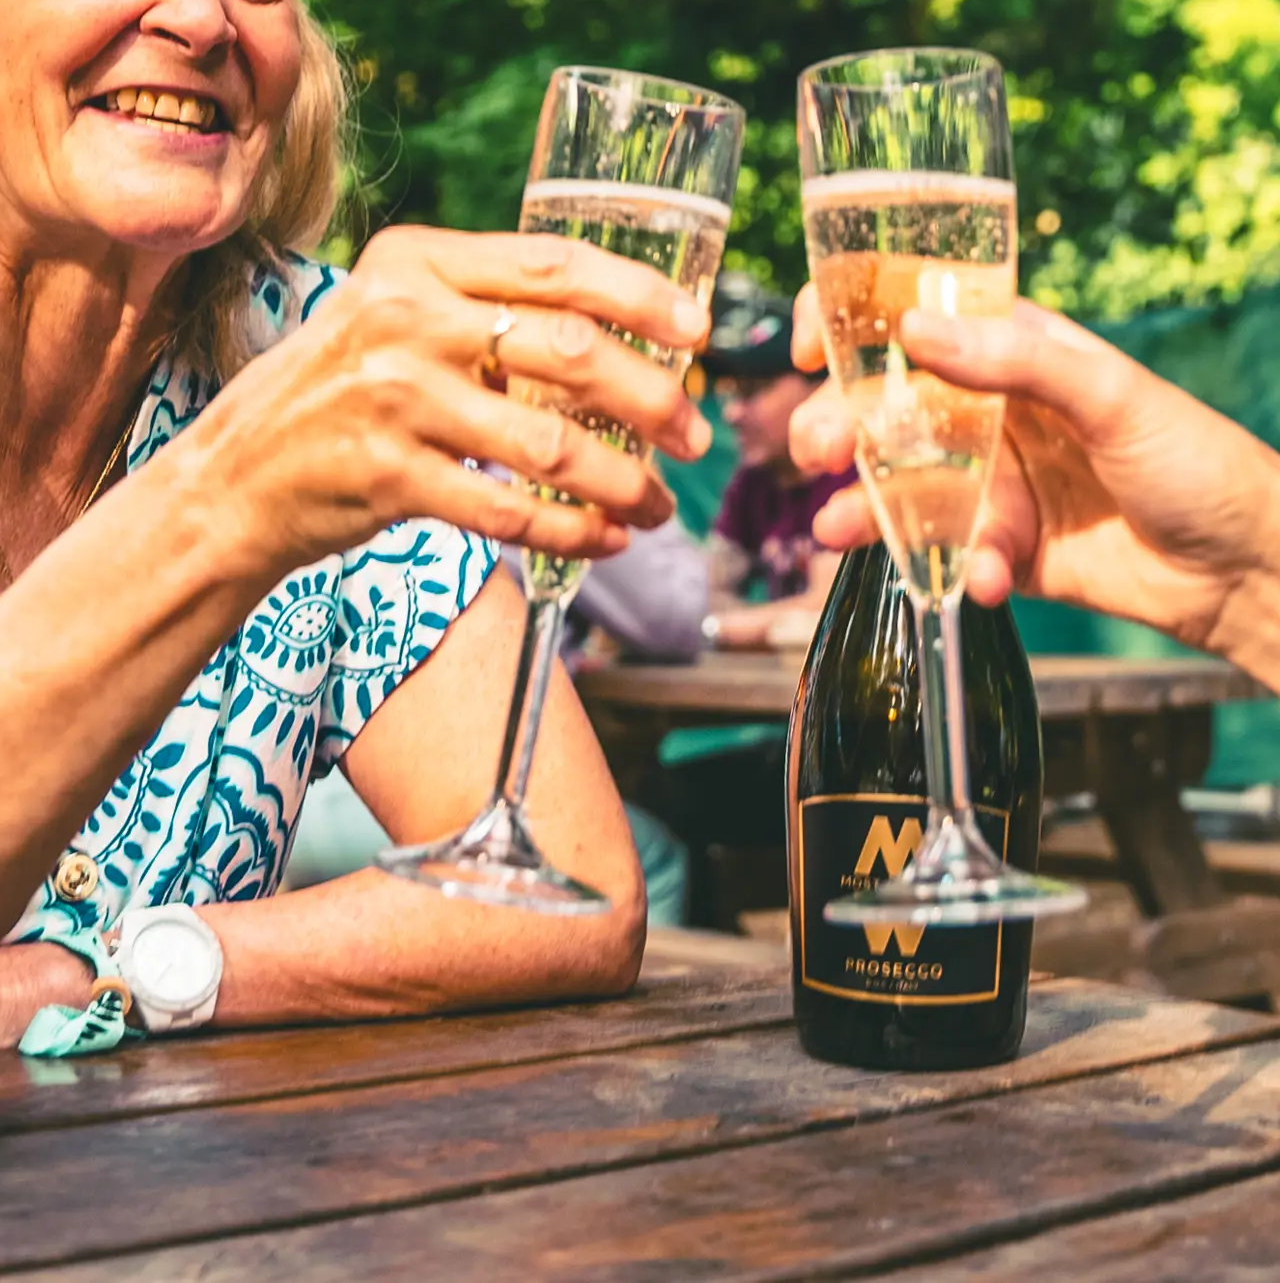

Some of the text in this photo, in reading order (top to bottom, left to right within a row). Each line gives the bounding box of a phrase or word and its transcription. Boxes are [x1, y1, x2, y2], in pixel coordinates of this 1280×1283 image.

[854, 815, 924, 877] M
[862, 919, 927, 957] W
[845, 957, 943, 981] PROSECCO
